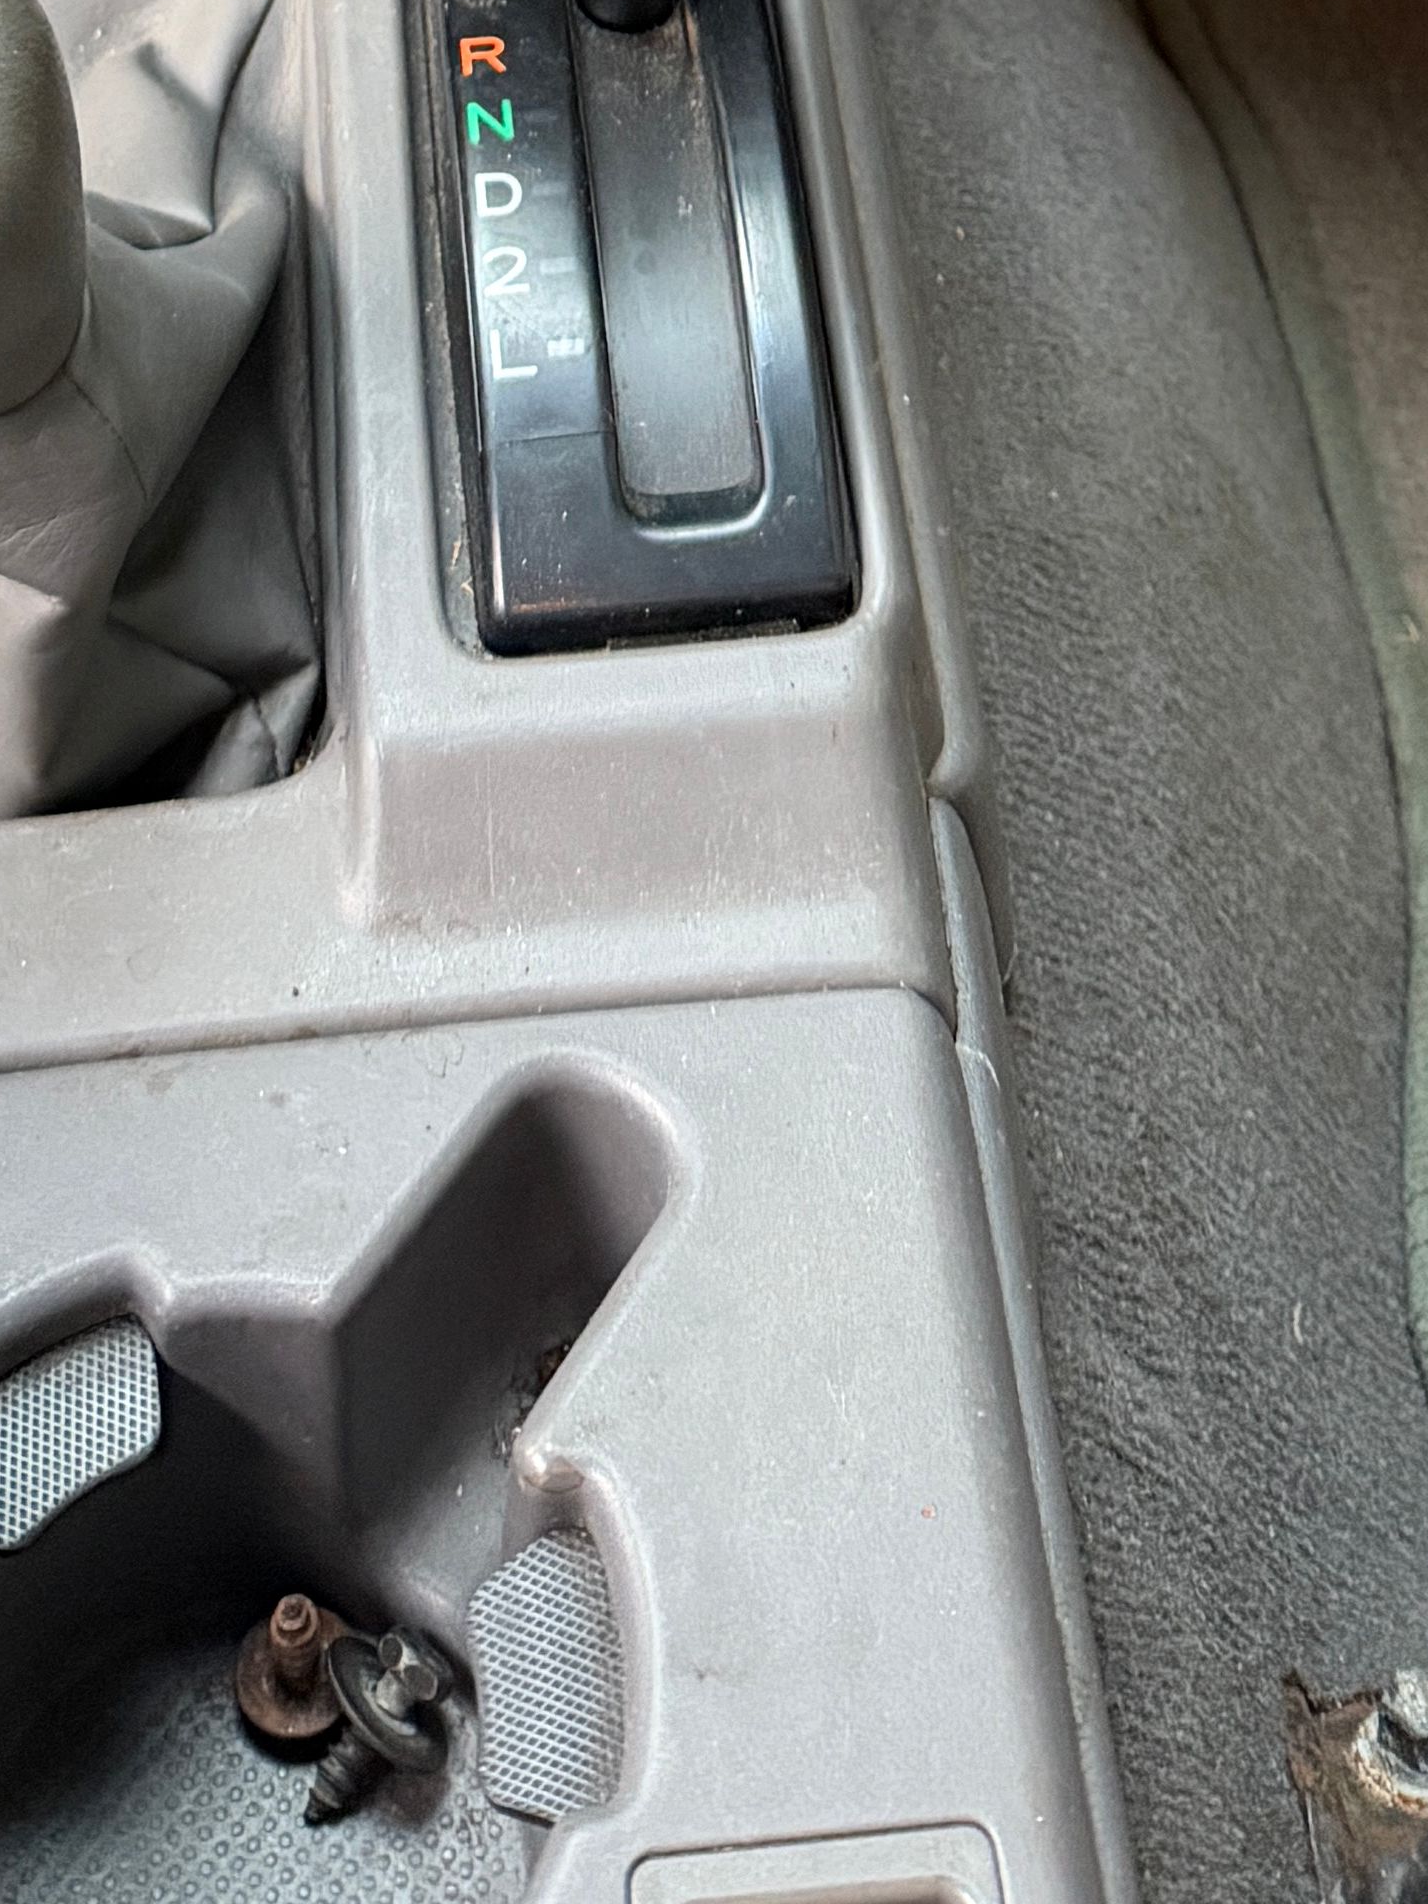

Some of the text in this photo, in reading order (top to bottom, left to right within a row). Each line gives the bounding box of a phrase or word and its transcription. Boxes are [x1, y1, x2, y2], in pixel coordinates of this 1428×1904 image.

[459, 36, 507, 77] R
[465, 99, 515, 145] N
[474, 172, 523, 218] D
[482, 245, 530, 293] 2
[489, 329, 538, 380] L
